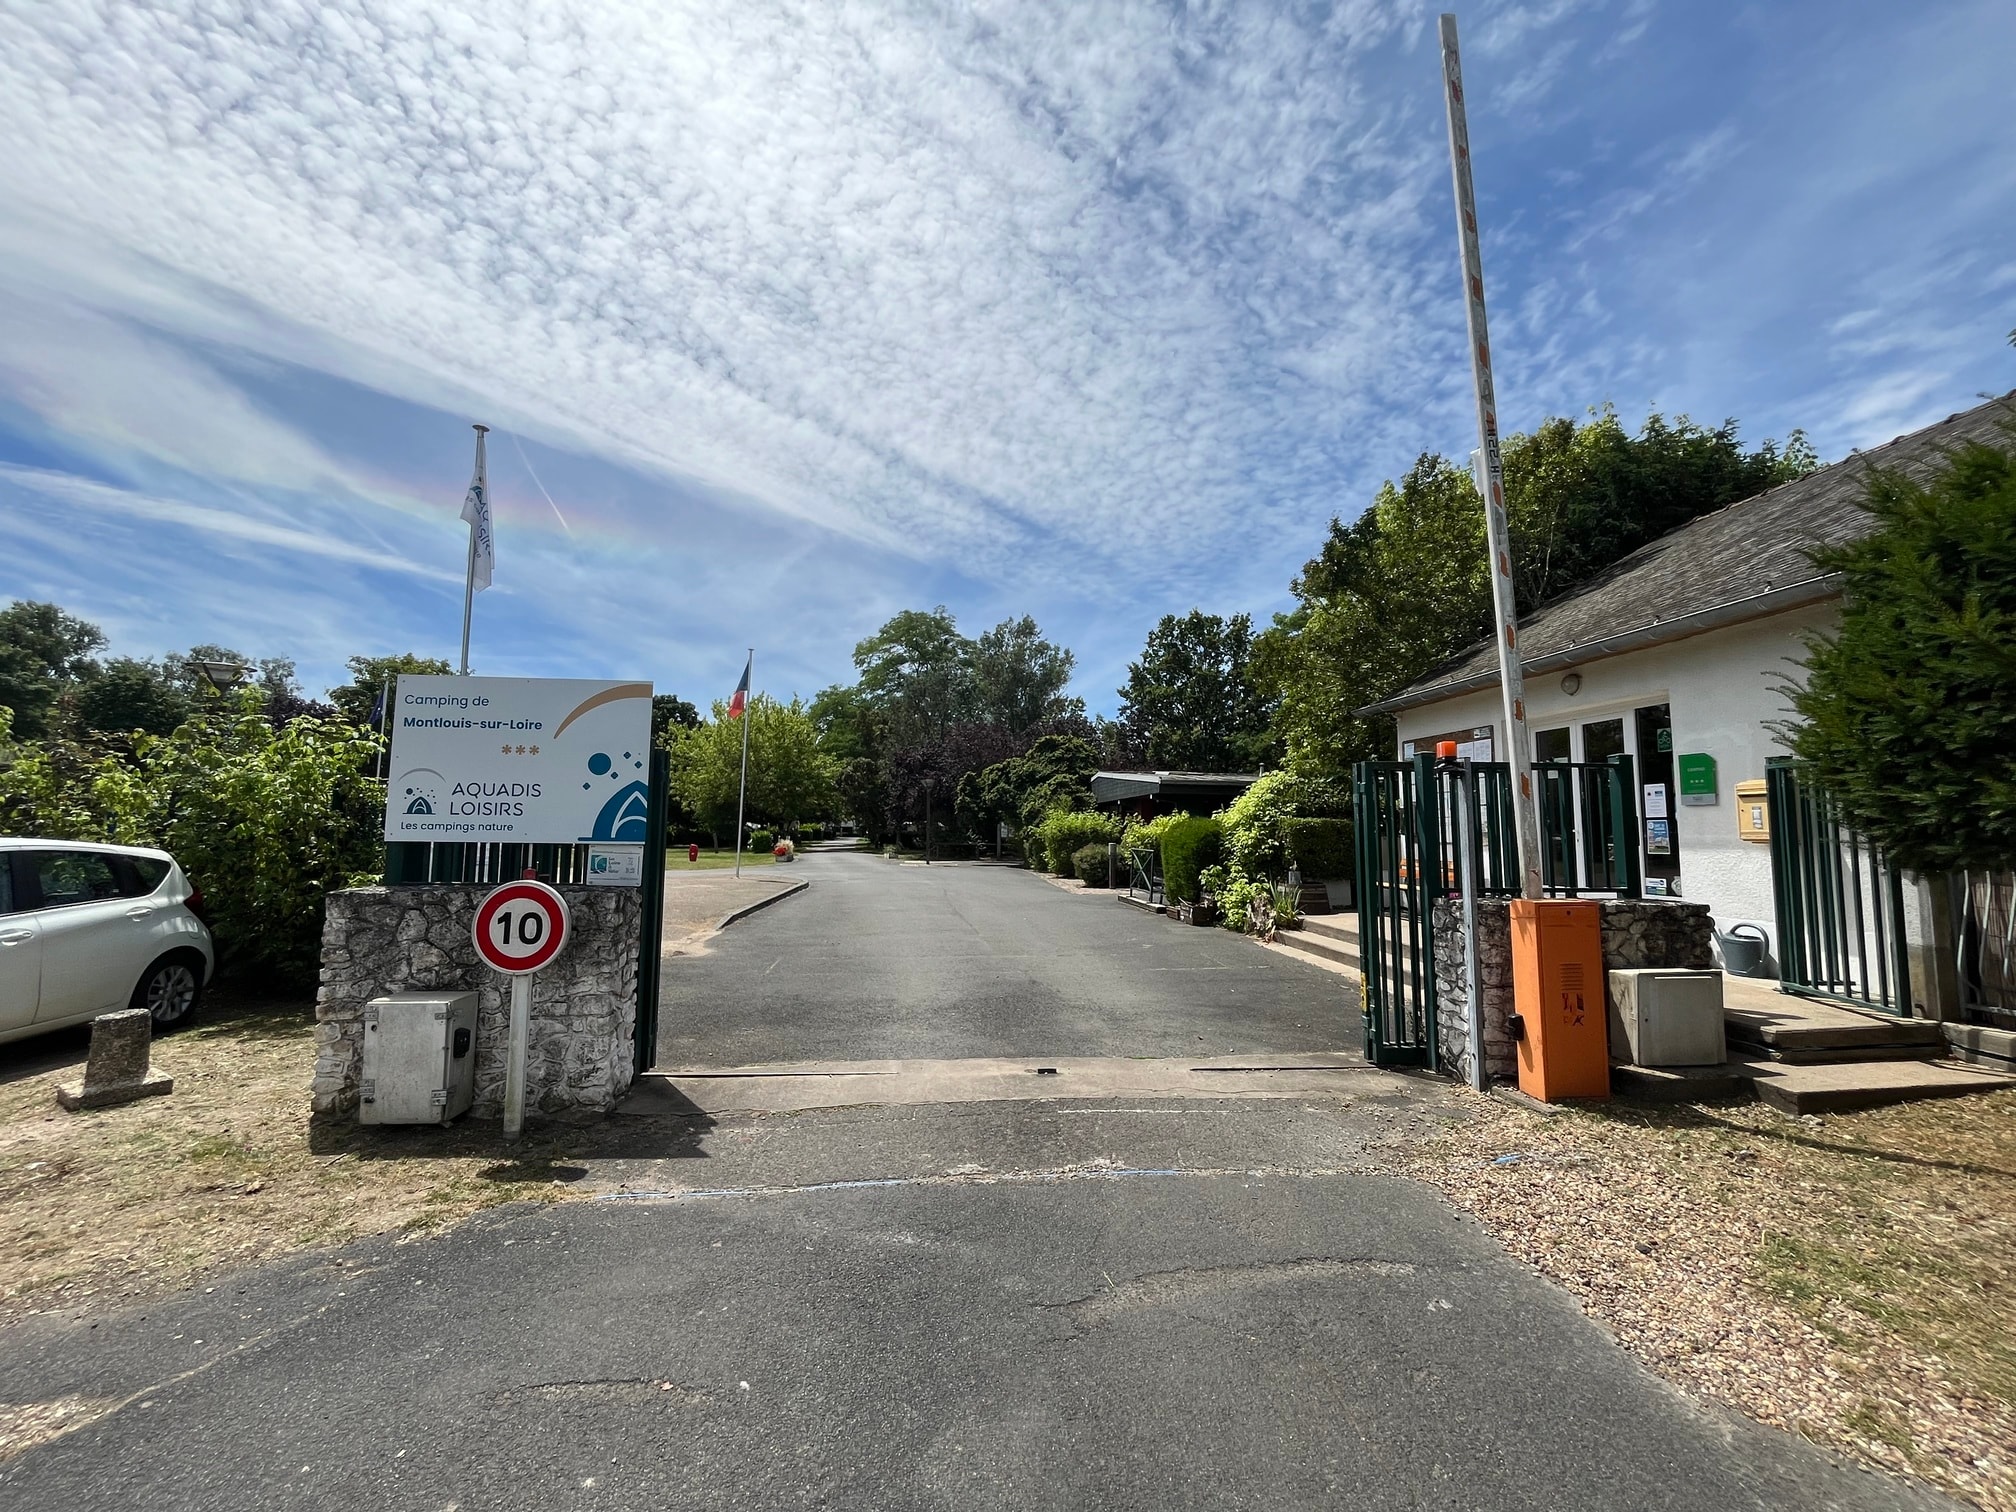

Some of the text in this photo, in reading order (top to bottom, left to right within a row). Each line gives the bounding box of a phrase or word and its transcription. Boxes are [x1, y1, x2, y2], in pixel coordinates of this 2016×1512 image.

[404, 694, 490, 709] Camping de
[403, 717, 543, 730] Montlouis-sur-Loire
[451, 782, 541, 799] AQUADIS
[449, 801, 524, 816] LOISIRS
[400, 822, 514, 833] Les campings nature
[497, 911, 543, 945] 10
